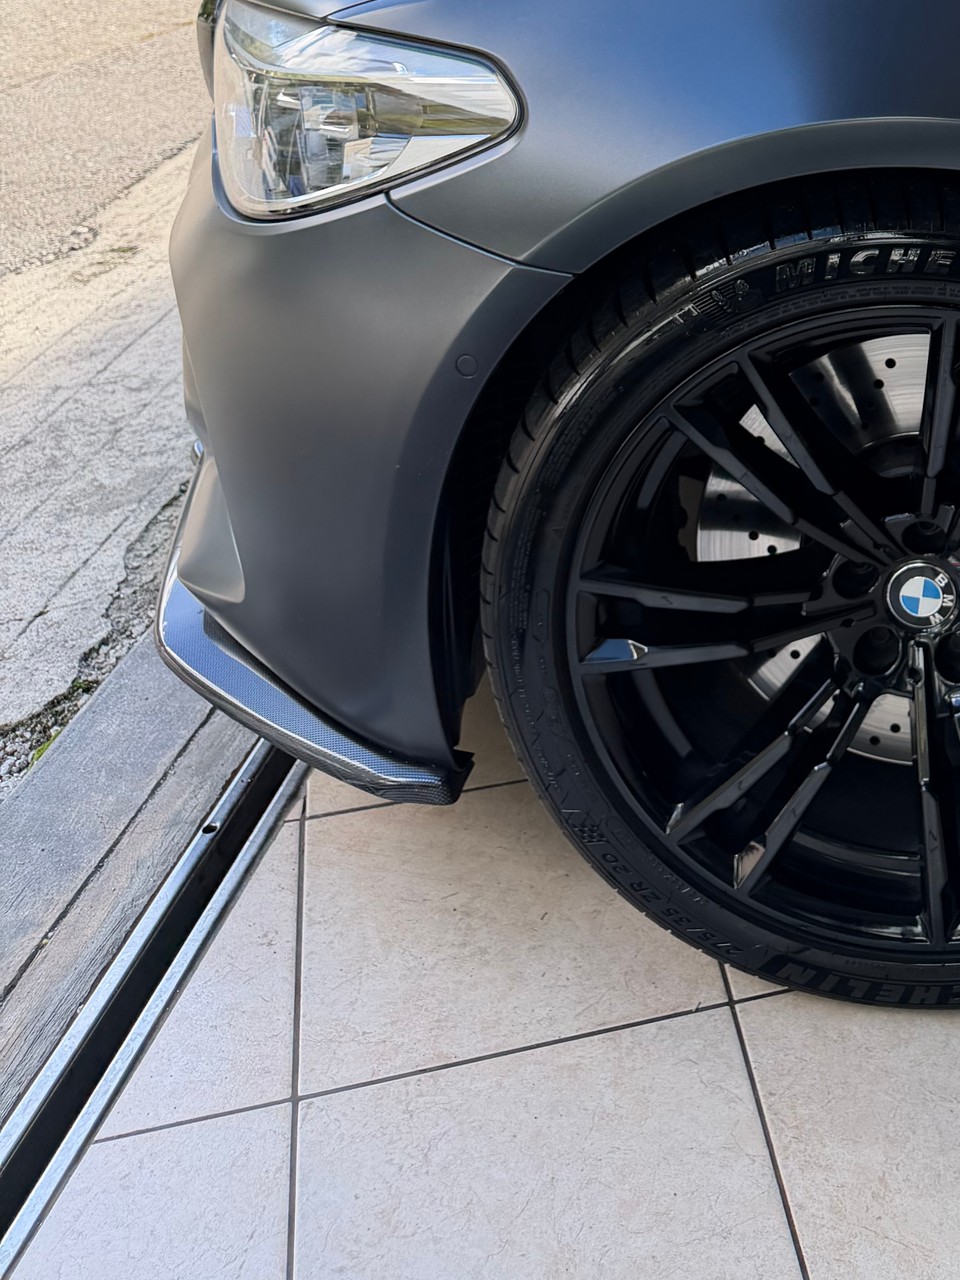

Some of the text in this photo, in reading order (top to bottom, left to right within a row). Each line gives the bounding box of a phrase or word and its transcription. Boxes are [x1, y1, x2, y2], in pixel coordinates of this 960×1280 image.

[929, 573, 954, 626] BMW
[602, 852, 632, 875] 20
[629, 878, 663, 904] ZR
[661, 907, 744, 957] 275/35
